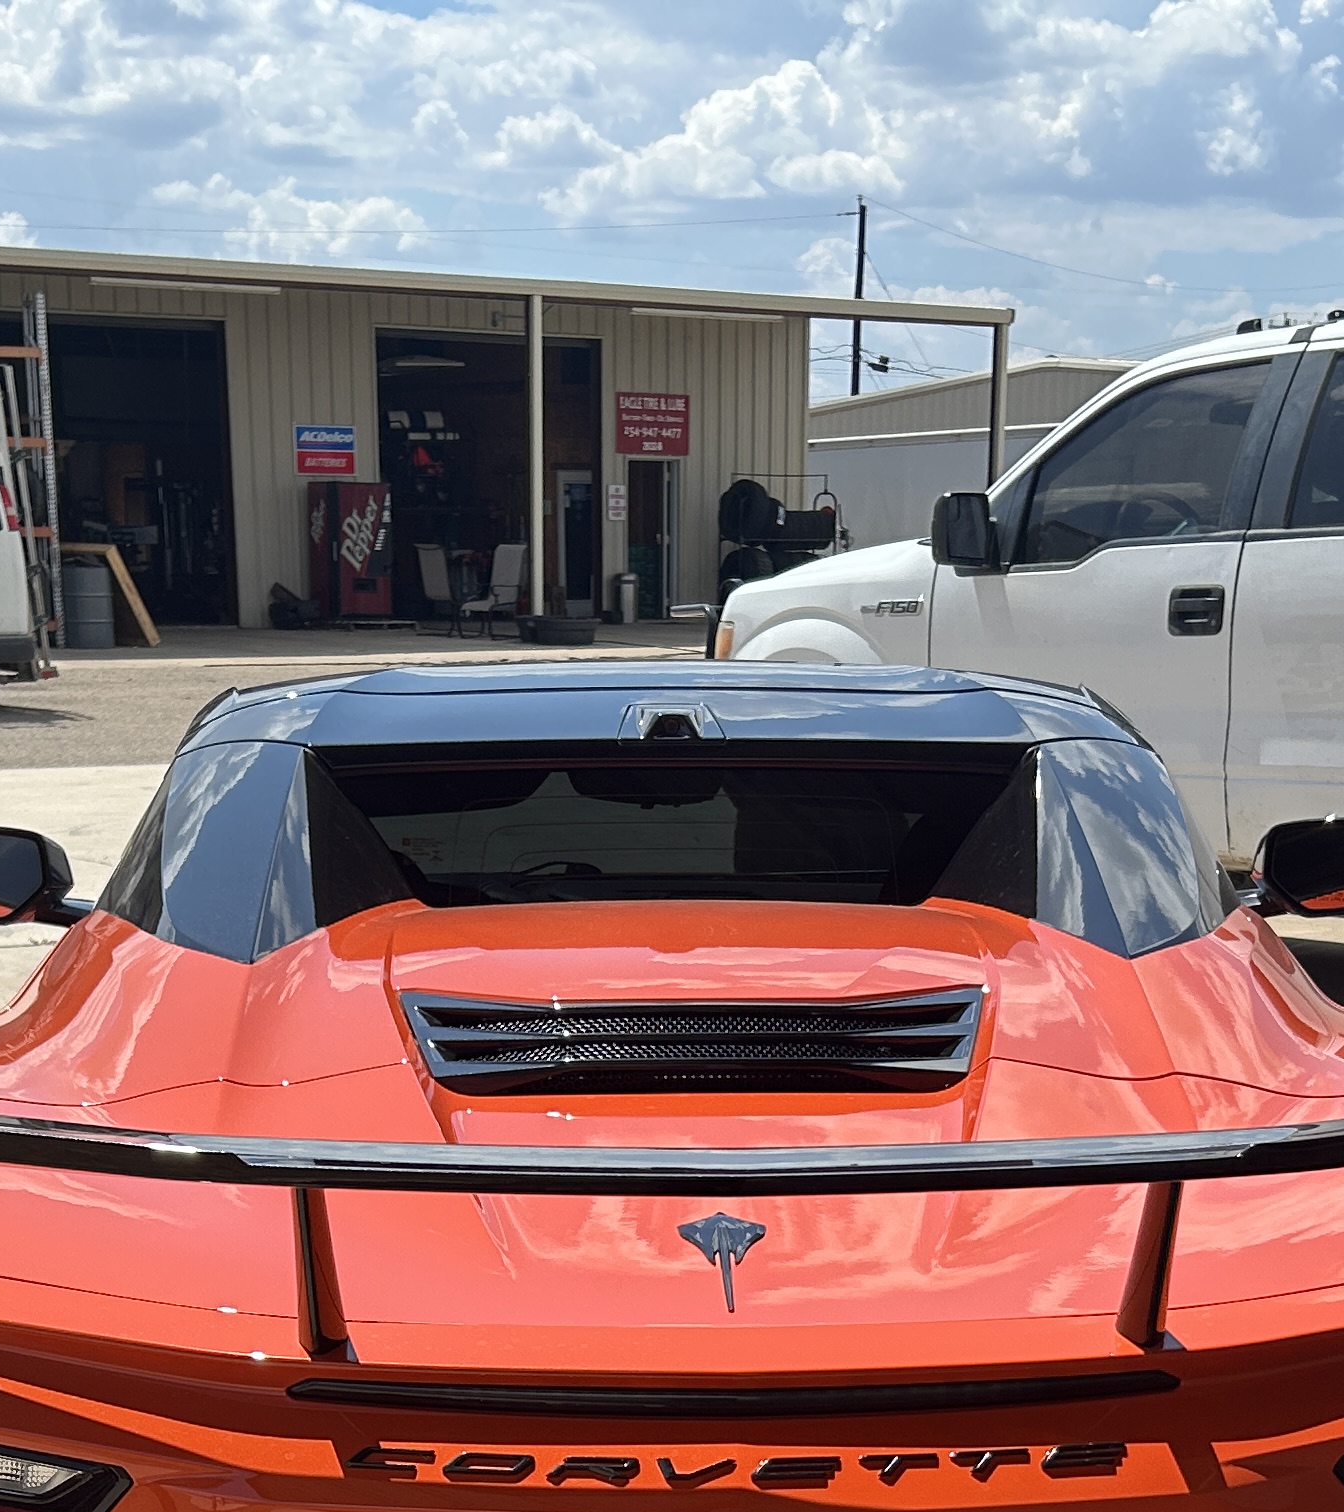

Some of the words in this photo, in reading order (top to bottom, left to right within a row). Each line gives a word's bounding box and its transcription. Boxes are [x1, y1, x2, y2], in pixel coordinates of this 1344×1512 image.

[340, 495, 378, 572] Pepper
[342, 507, 362, 540] Dr
[344, 1441, 1127, 1490] CORVETTE
